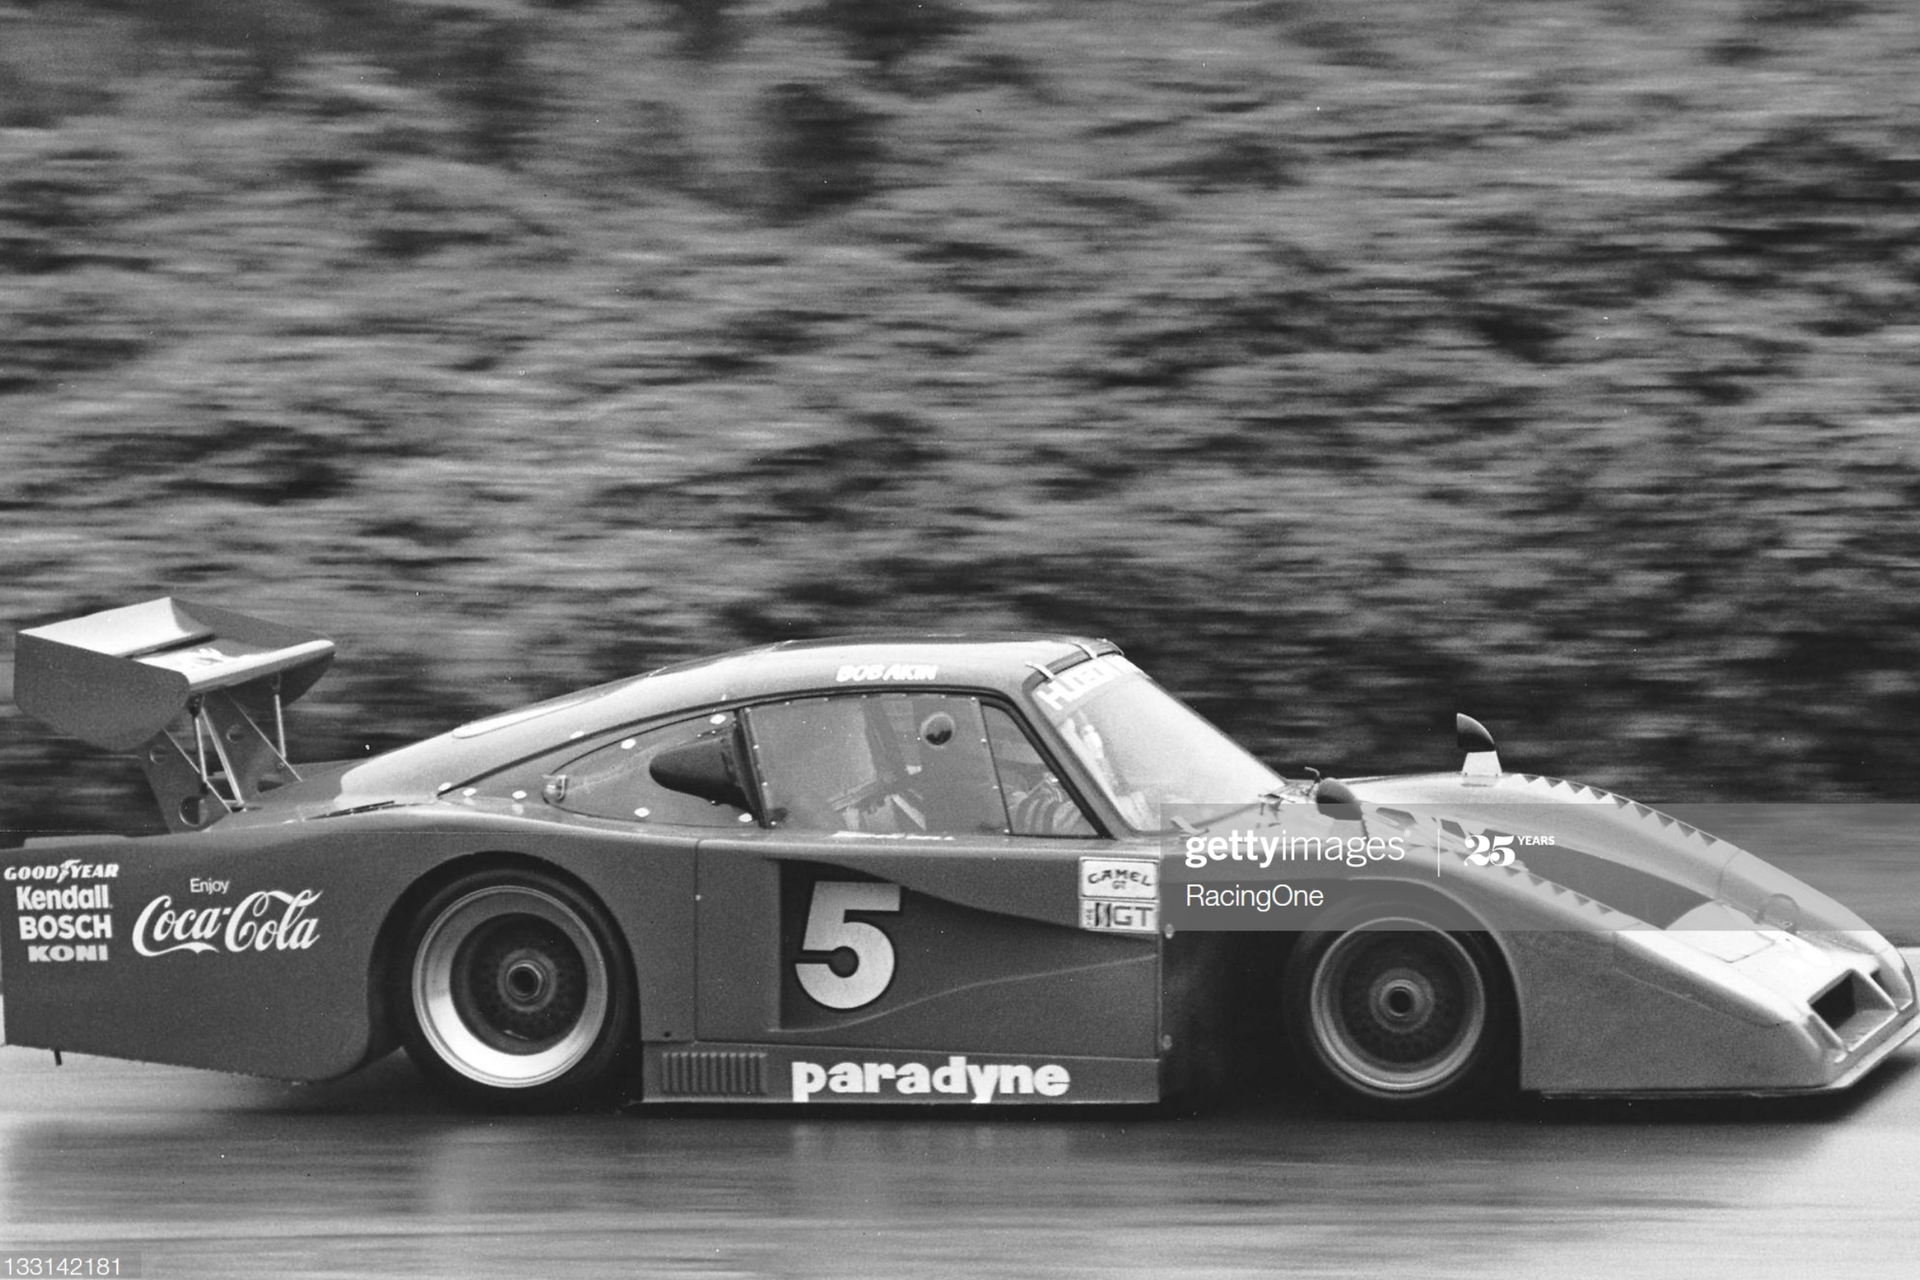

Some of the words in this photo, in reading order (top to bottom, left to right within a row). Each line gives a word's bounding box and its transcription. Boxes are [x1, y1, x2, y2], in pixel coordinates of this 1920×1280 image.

[3, 859, 119, 883] GOODYEAR
[1087, 869, 1153, 887] CAMEL
[190, 878, 230, 894] Enjoy
[19, 914, 112, 940] BOSCH
[132, 890, 323, 957] Coca-Cola
[28, 945, 108, 962] KONI
[796, 881, 900, 1009] 5
[792, 1055, 1071, 1104] paradyne
